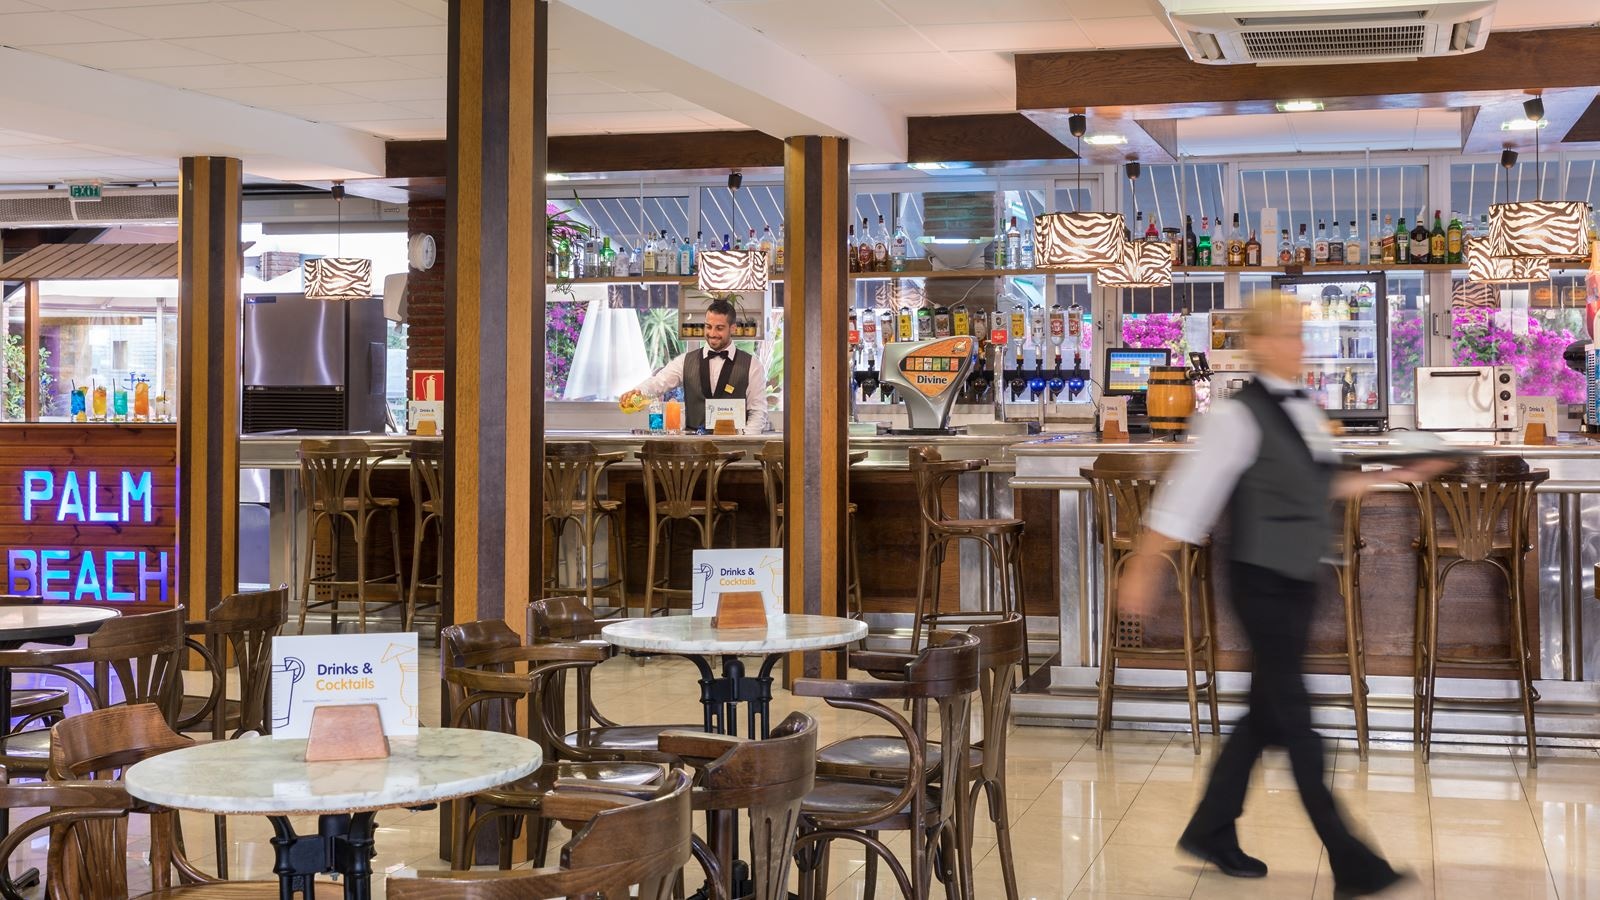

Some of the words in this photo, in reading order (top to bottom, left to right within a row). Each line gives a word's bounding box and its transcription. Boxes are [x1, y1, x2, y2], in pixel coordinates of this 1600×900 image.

[71, 185, 99, 197] EXIT
[917, 375, 948, 384] Divine
[23, 470, 152, 522] PALM
[8, 549, 168, 602] BEACH
[720, 567, 746, 576] Drinks
[747, 567, 755, 576] &
[720, 577, 757, 586] Cocktails
[317, 663, 359, 676] Drinks
[362, 662, 374, 675] &
[316, 677, 375, 691] Cocktails
